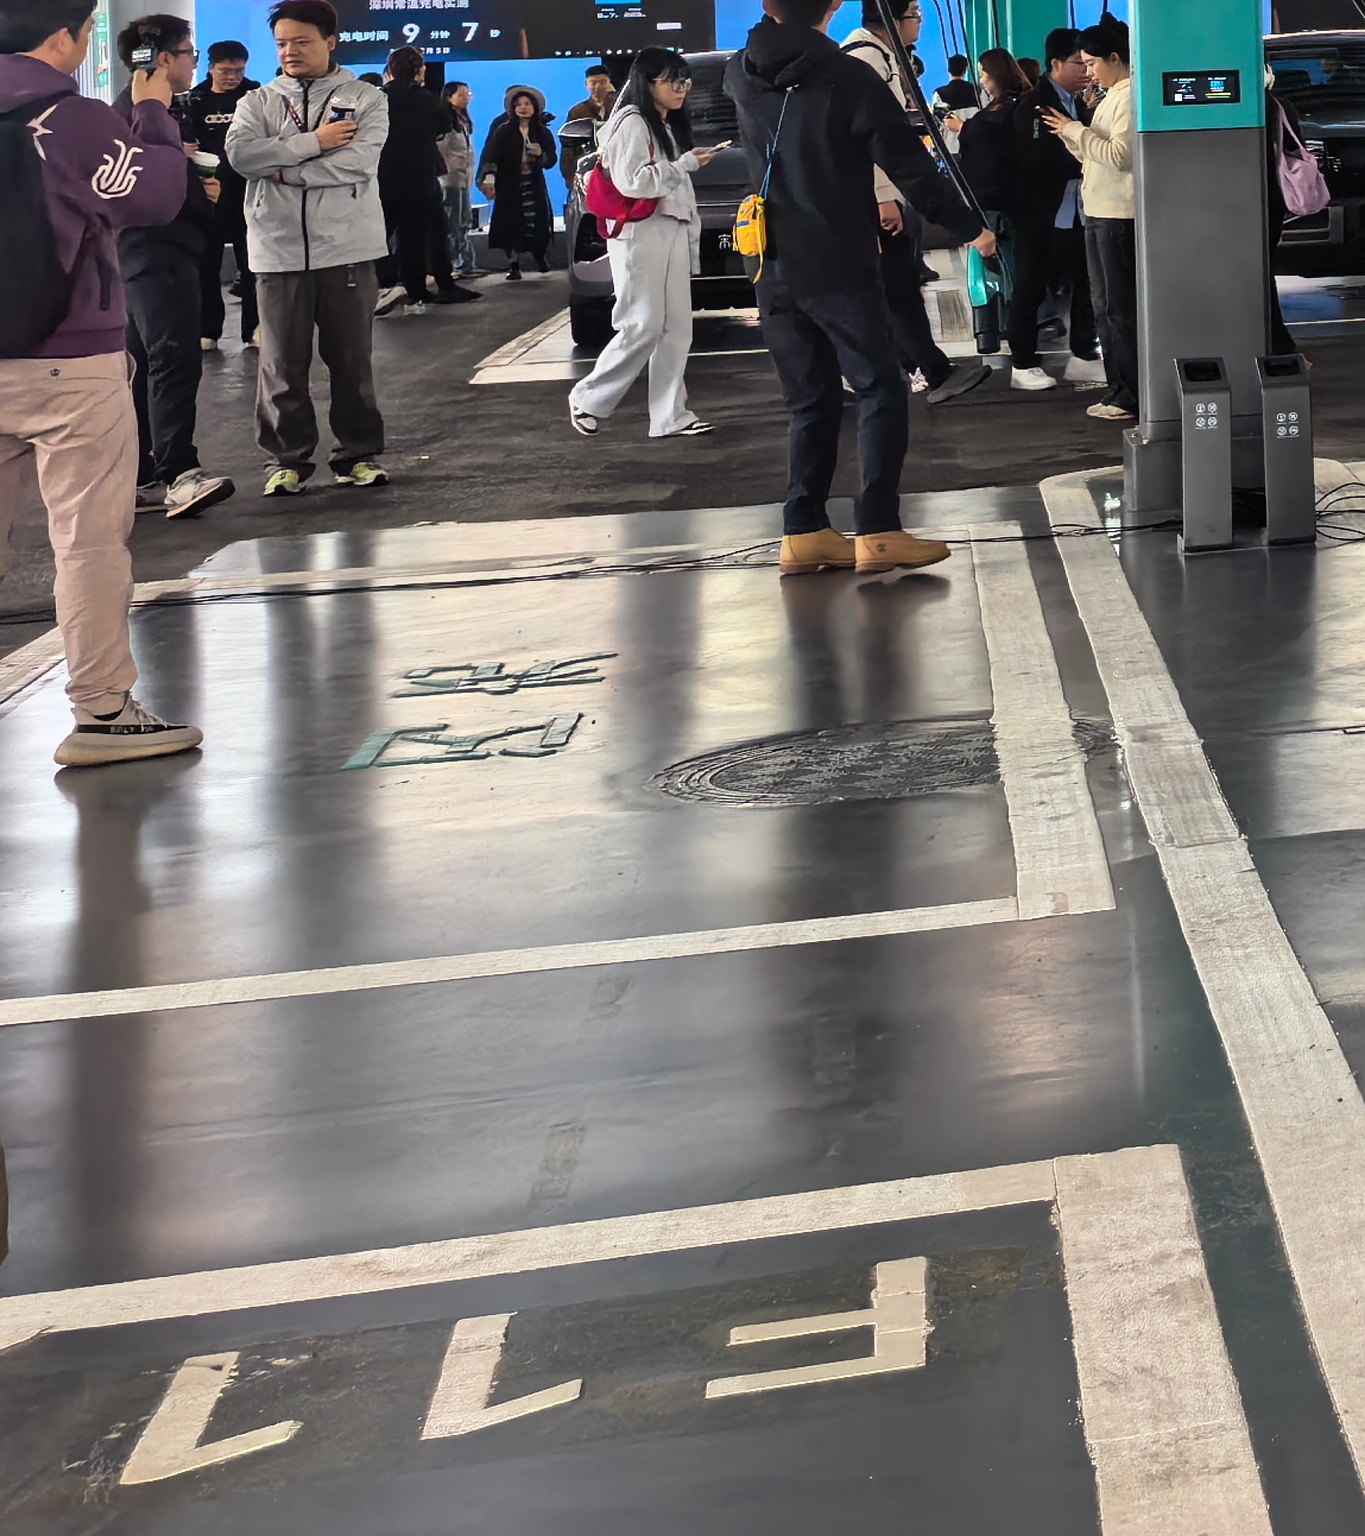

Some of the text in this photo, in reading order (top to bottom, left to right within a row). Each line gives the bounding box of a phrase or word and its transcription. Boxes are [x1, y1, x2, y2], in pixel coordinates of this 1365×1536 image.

[339, 30, 389, 43] 充电时间
[402, 23, 420, 44] 9
[462, 21, 479, 43] 7
